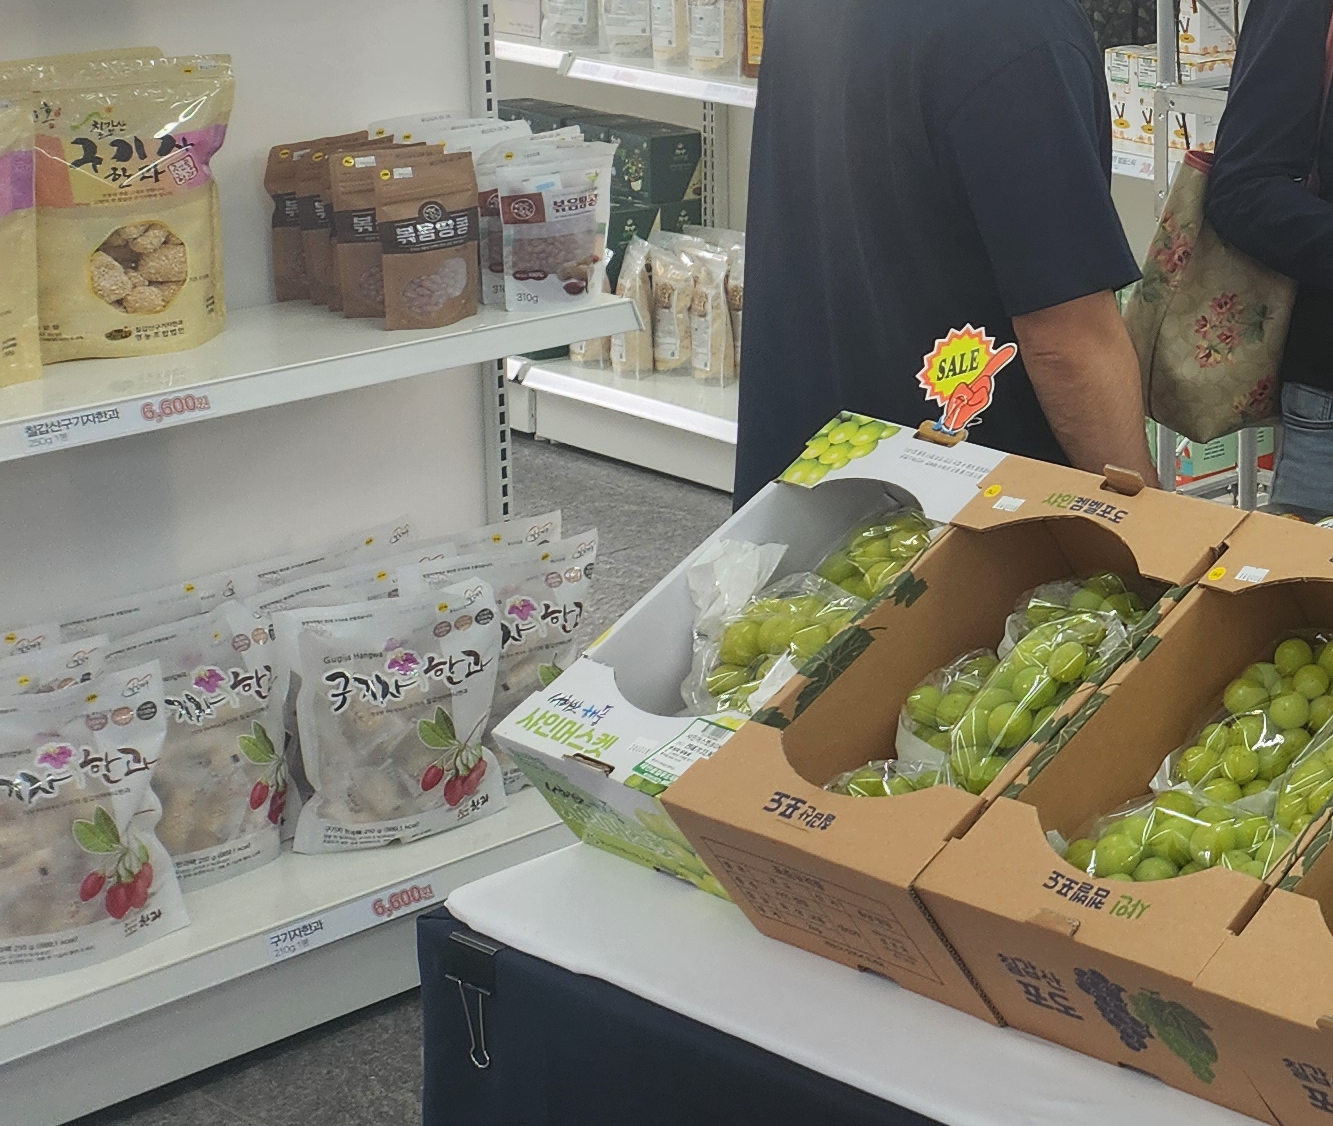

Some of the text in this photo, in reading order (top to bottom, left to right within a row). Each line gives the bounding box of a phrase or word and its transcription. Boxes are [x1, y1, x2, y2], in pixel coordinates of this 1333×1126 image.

[69, 134, 196, 174] 구기자
[104, 163, 167, 190] 한과
[395, 213, 469, 246] 볶음땅콩
[515, 291, 539, 304] 310g
[935, 347, 981, 382] SALE
[24, 407, 120, 438] 칠갑산구기자한과
[140, 393, 211, 424] 6,600원
[1042, 492, 1073, 509] 샤인
[323, 651, 384, 665] Gugija Hangwa
[325, 649, 494, 713] 구기자 한과
[515, 706, 620, 758] 샤인머스켓
[79, 747, 160, 785] 한과
[761, 791, 837, 831] 칠갑산 포도
[371, 884, 435, 918] 6,600원
[1109, 894, 1151, 920] 샤인
[269, 919, 324, 947] 구기자한과
[1016, 978, 1084, 1022] 포도
